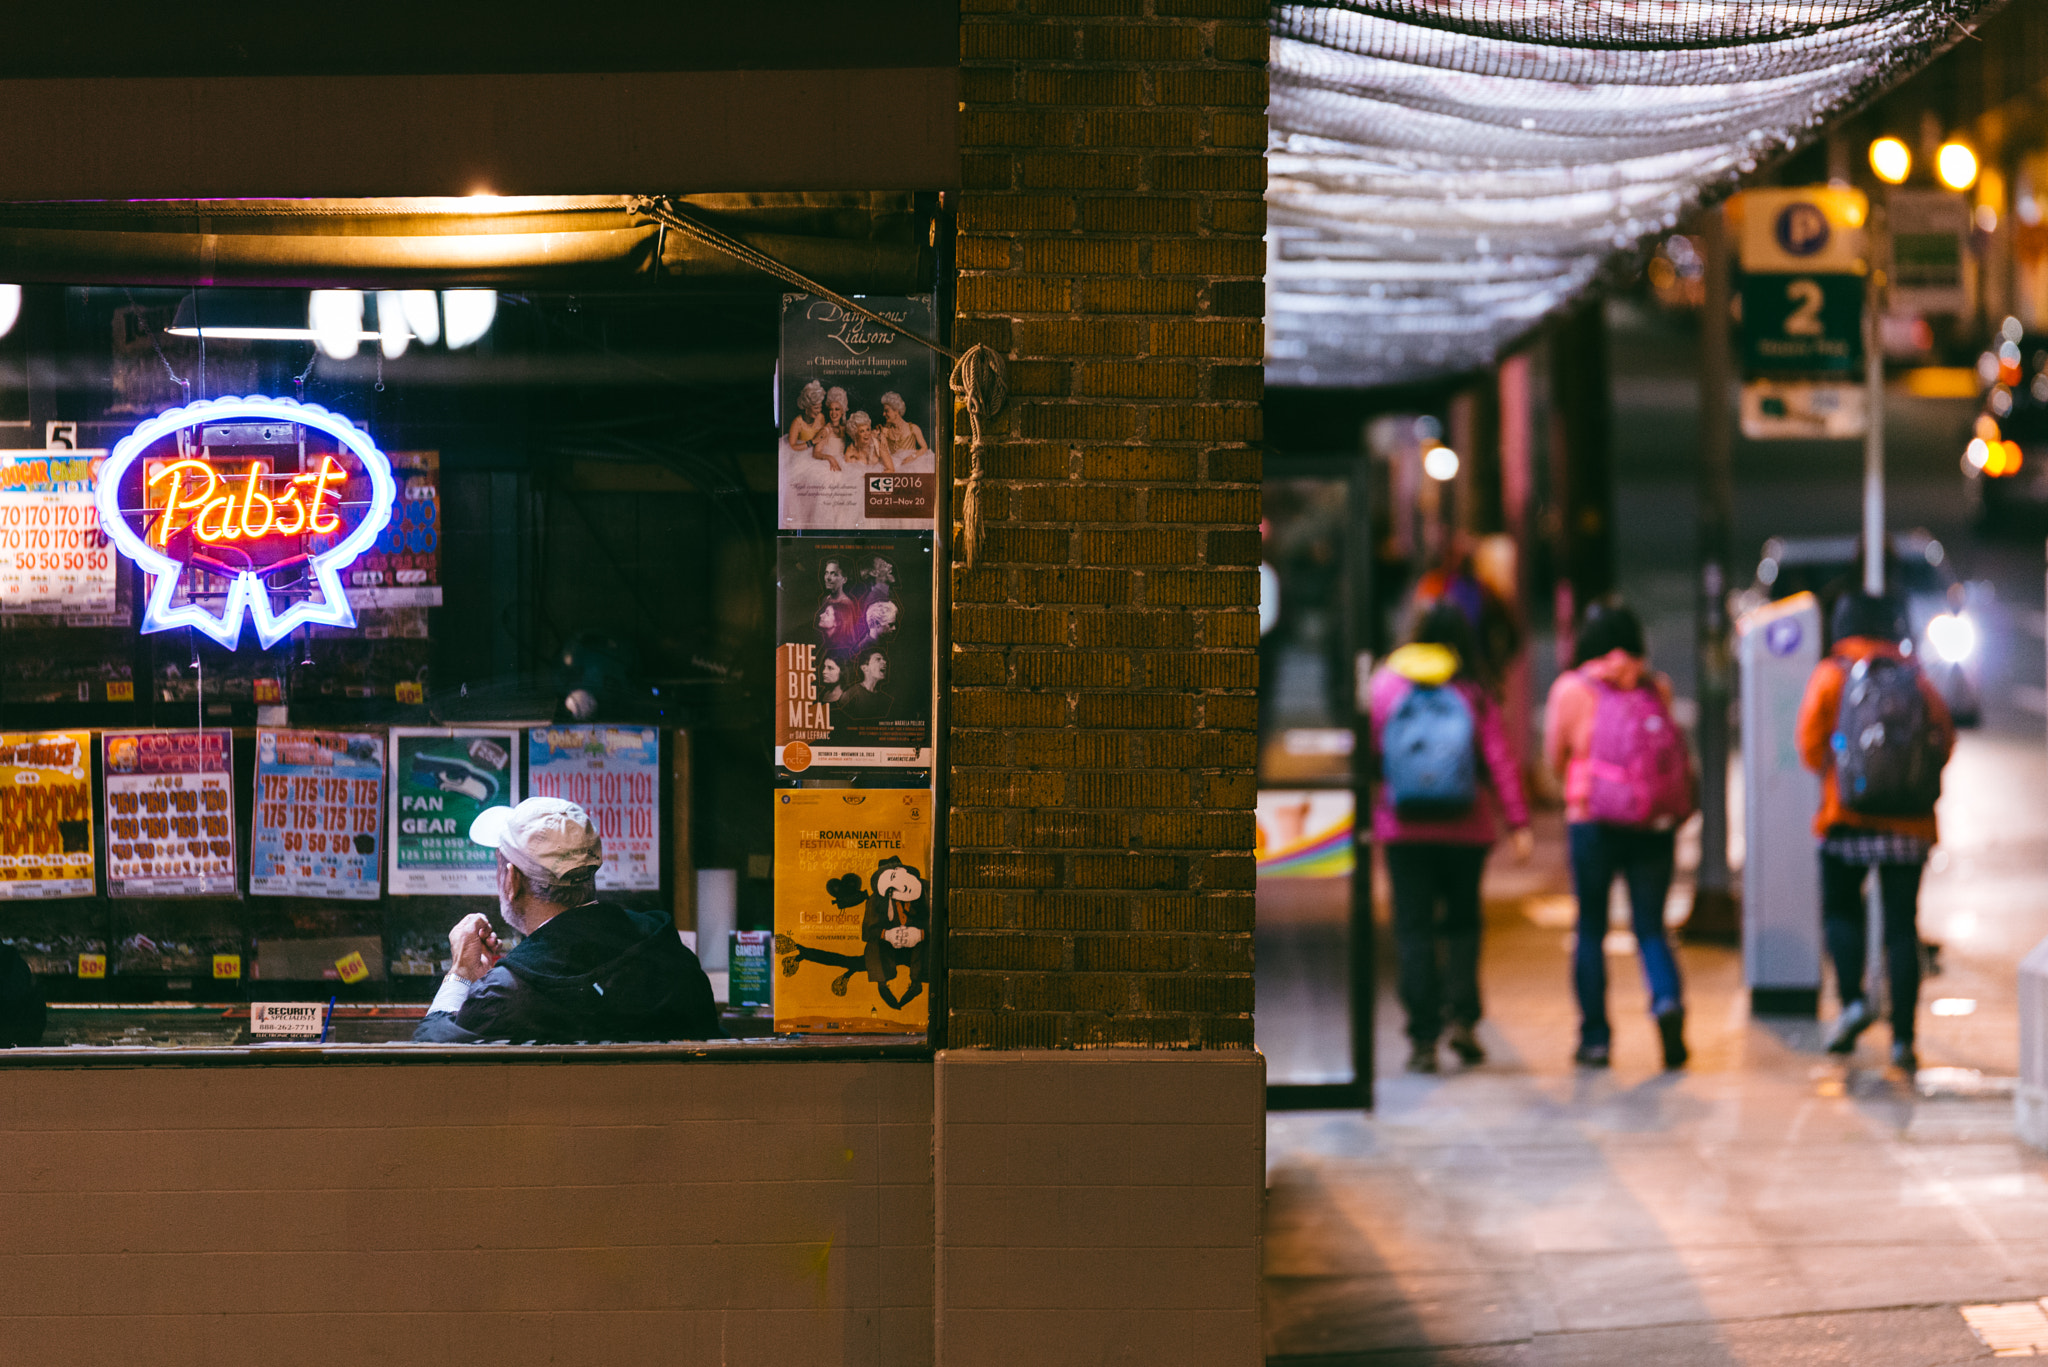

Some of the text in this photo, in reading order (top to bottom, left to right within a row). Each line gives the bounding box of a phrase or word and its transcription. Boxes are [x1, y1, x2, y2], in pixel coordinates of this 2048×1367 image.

[1782, 279, 1824, 335] 2
[827, 322, 896, 355] Liaisons
[814, 356, 867, 369] Christopher
[867, 356, 908, 368] Hampton
[52, 426, 73, 450] 5
[0, 461, 50, 488] OUGAR
[894, 476, 922, 488] 2016
[148, 455, 348, 547] Pabst
[869, 497, 882, 505] Oct
[914, 497, 925, 505] 20
[785, 642, 817, 672] THE
[788, 671, 817, 701] BIG
[788, 700, 835, 731] MEAL
[795, 731, 806, 740] DAN
[139, 790, 168, 814] $160
[169, 789, 198, 813] $160
[402, 795, 444, 812] FAN
[141, 816, 169, 839] $160
[170, 816, 199, 838] $160
[402, 817, 457, 834] GEAR
[267, 1007, 316, 1015] SECURITY
